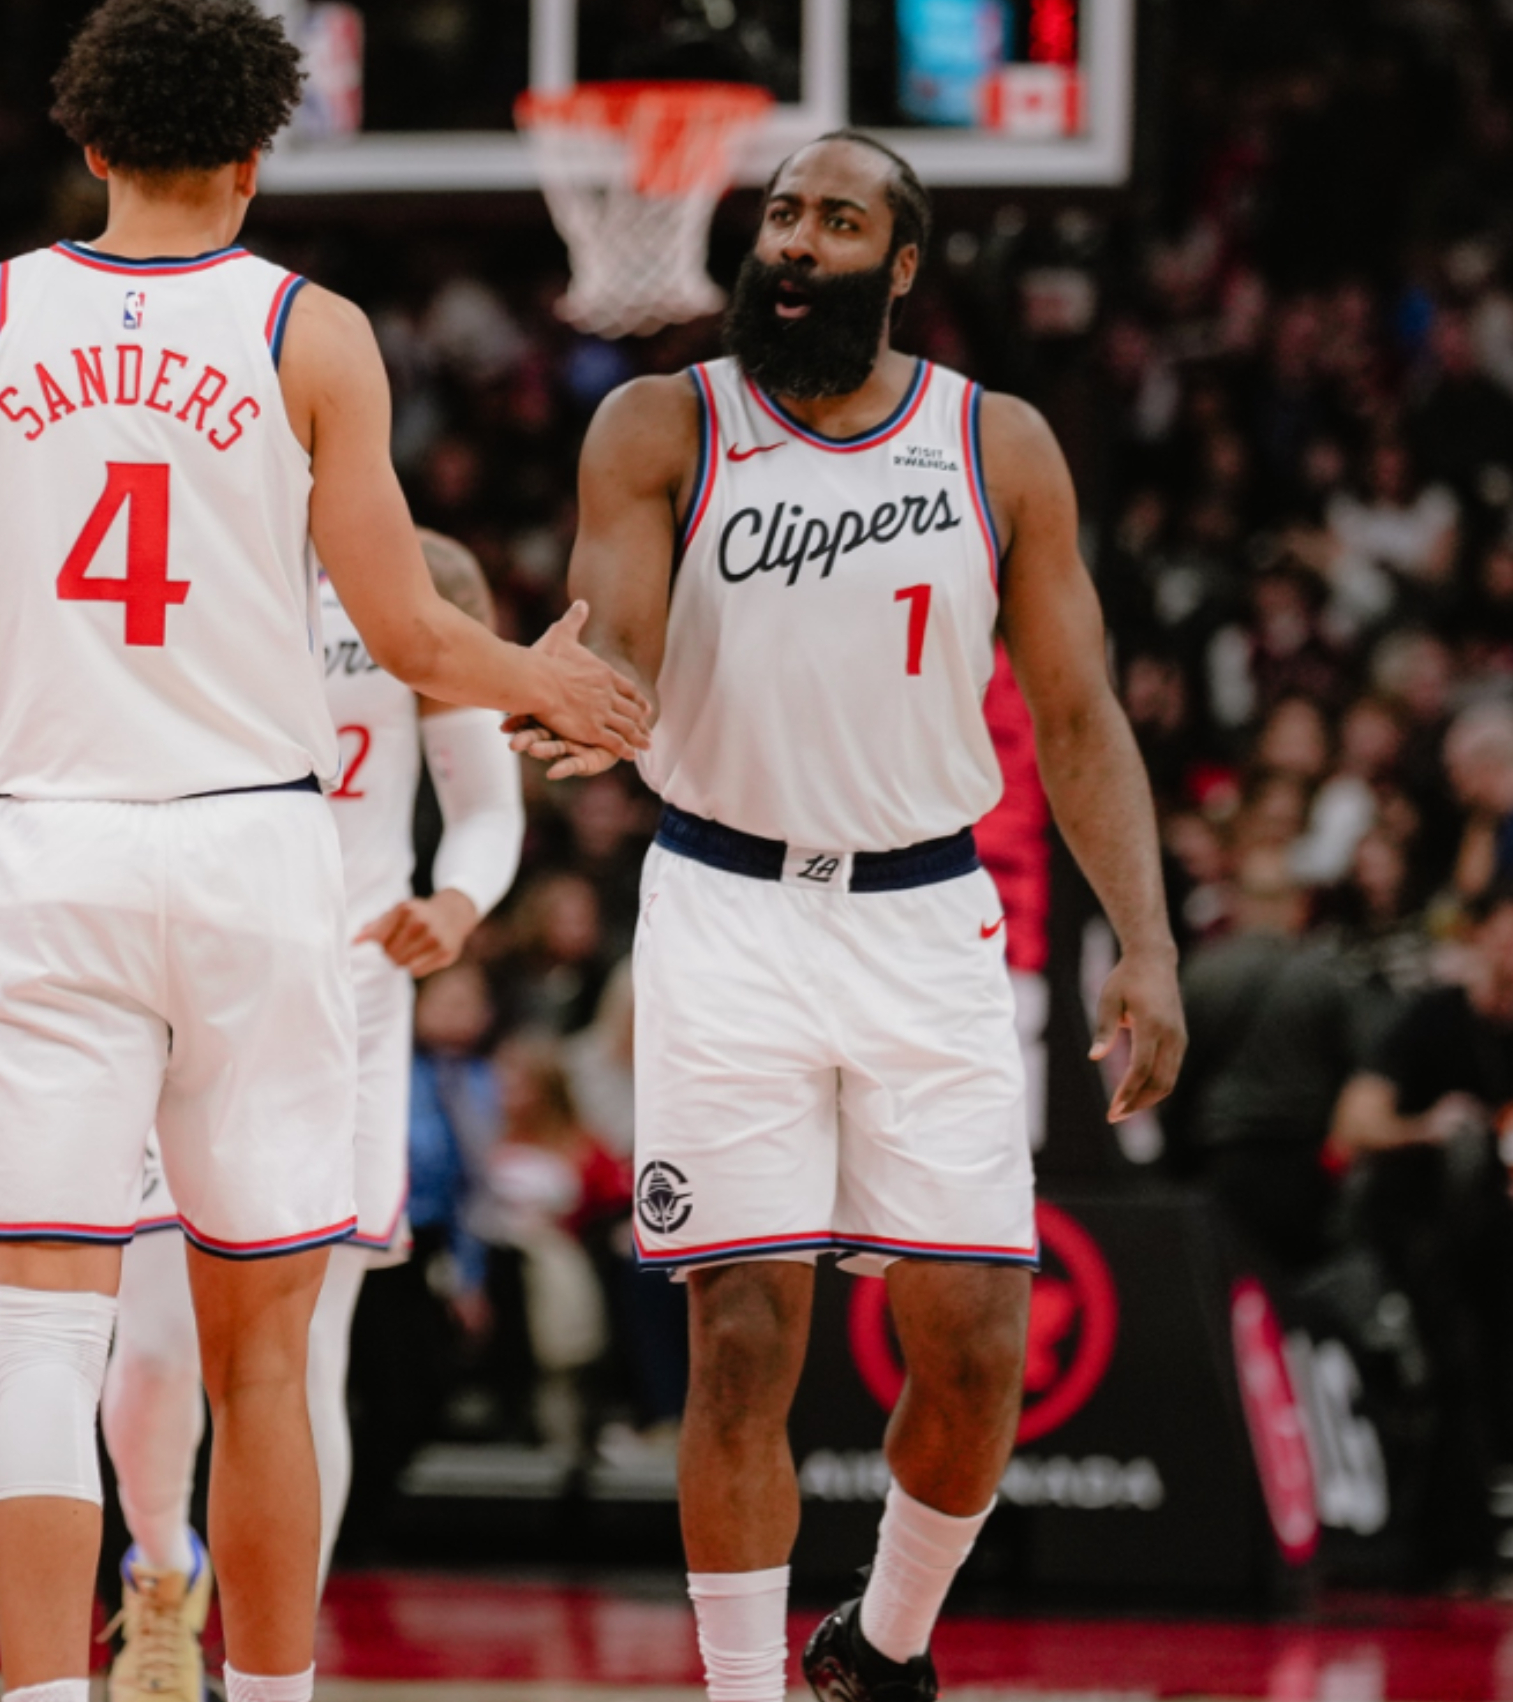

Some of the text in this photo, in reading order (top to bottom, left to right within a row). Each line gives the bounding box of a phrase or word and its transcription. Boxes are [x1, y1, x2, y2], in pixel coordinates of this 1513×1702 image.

[56, 461, 191, 647] 4
[718, 488, 963, 587] Clippers
[894, 583, 932, 676] 1
